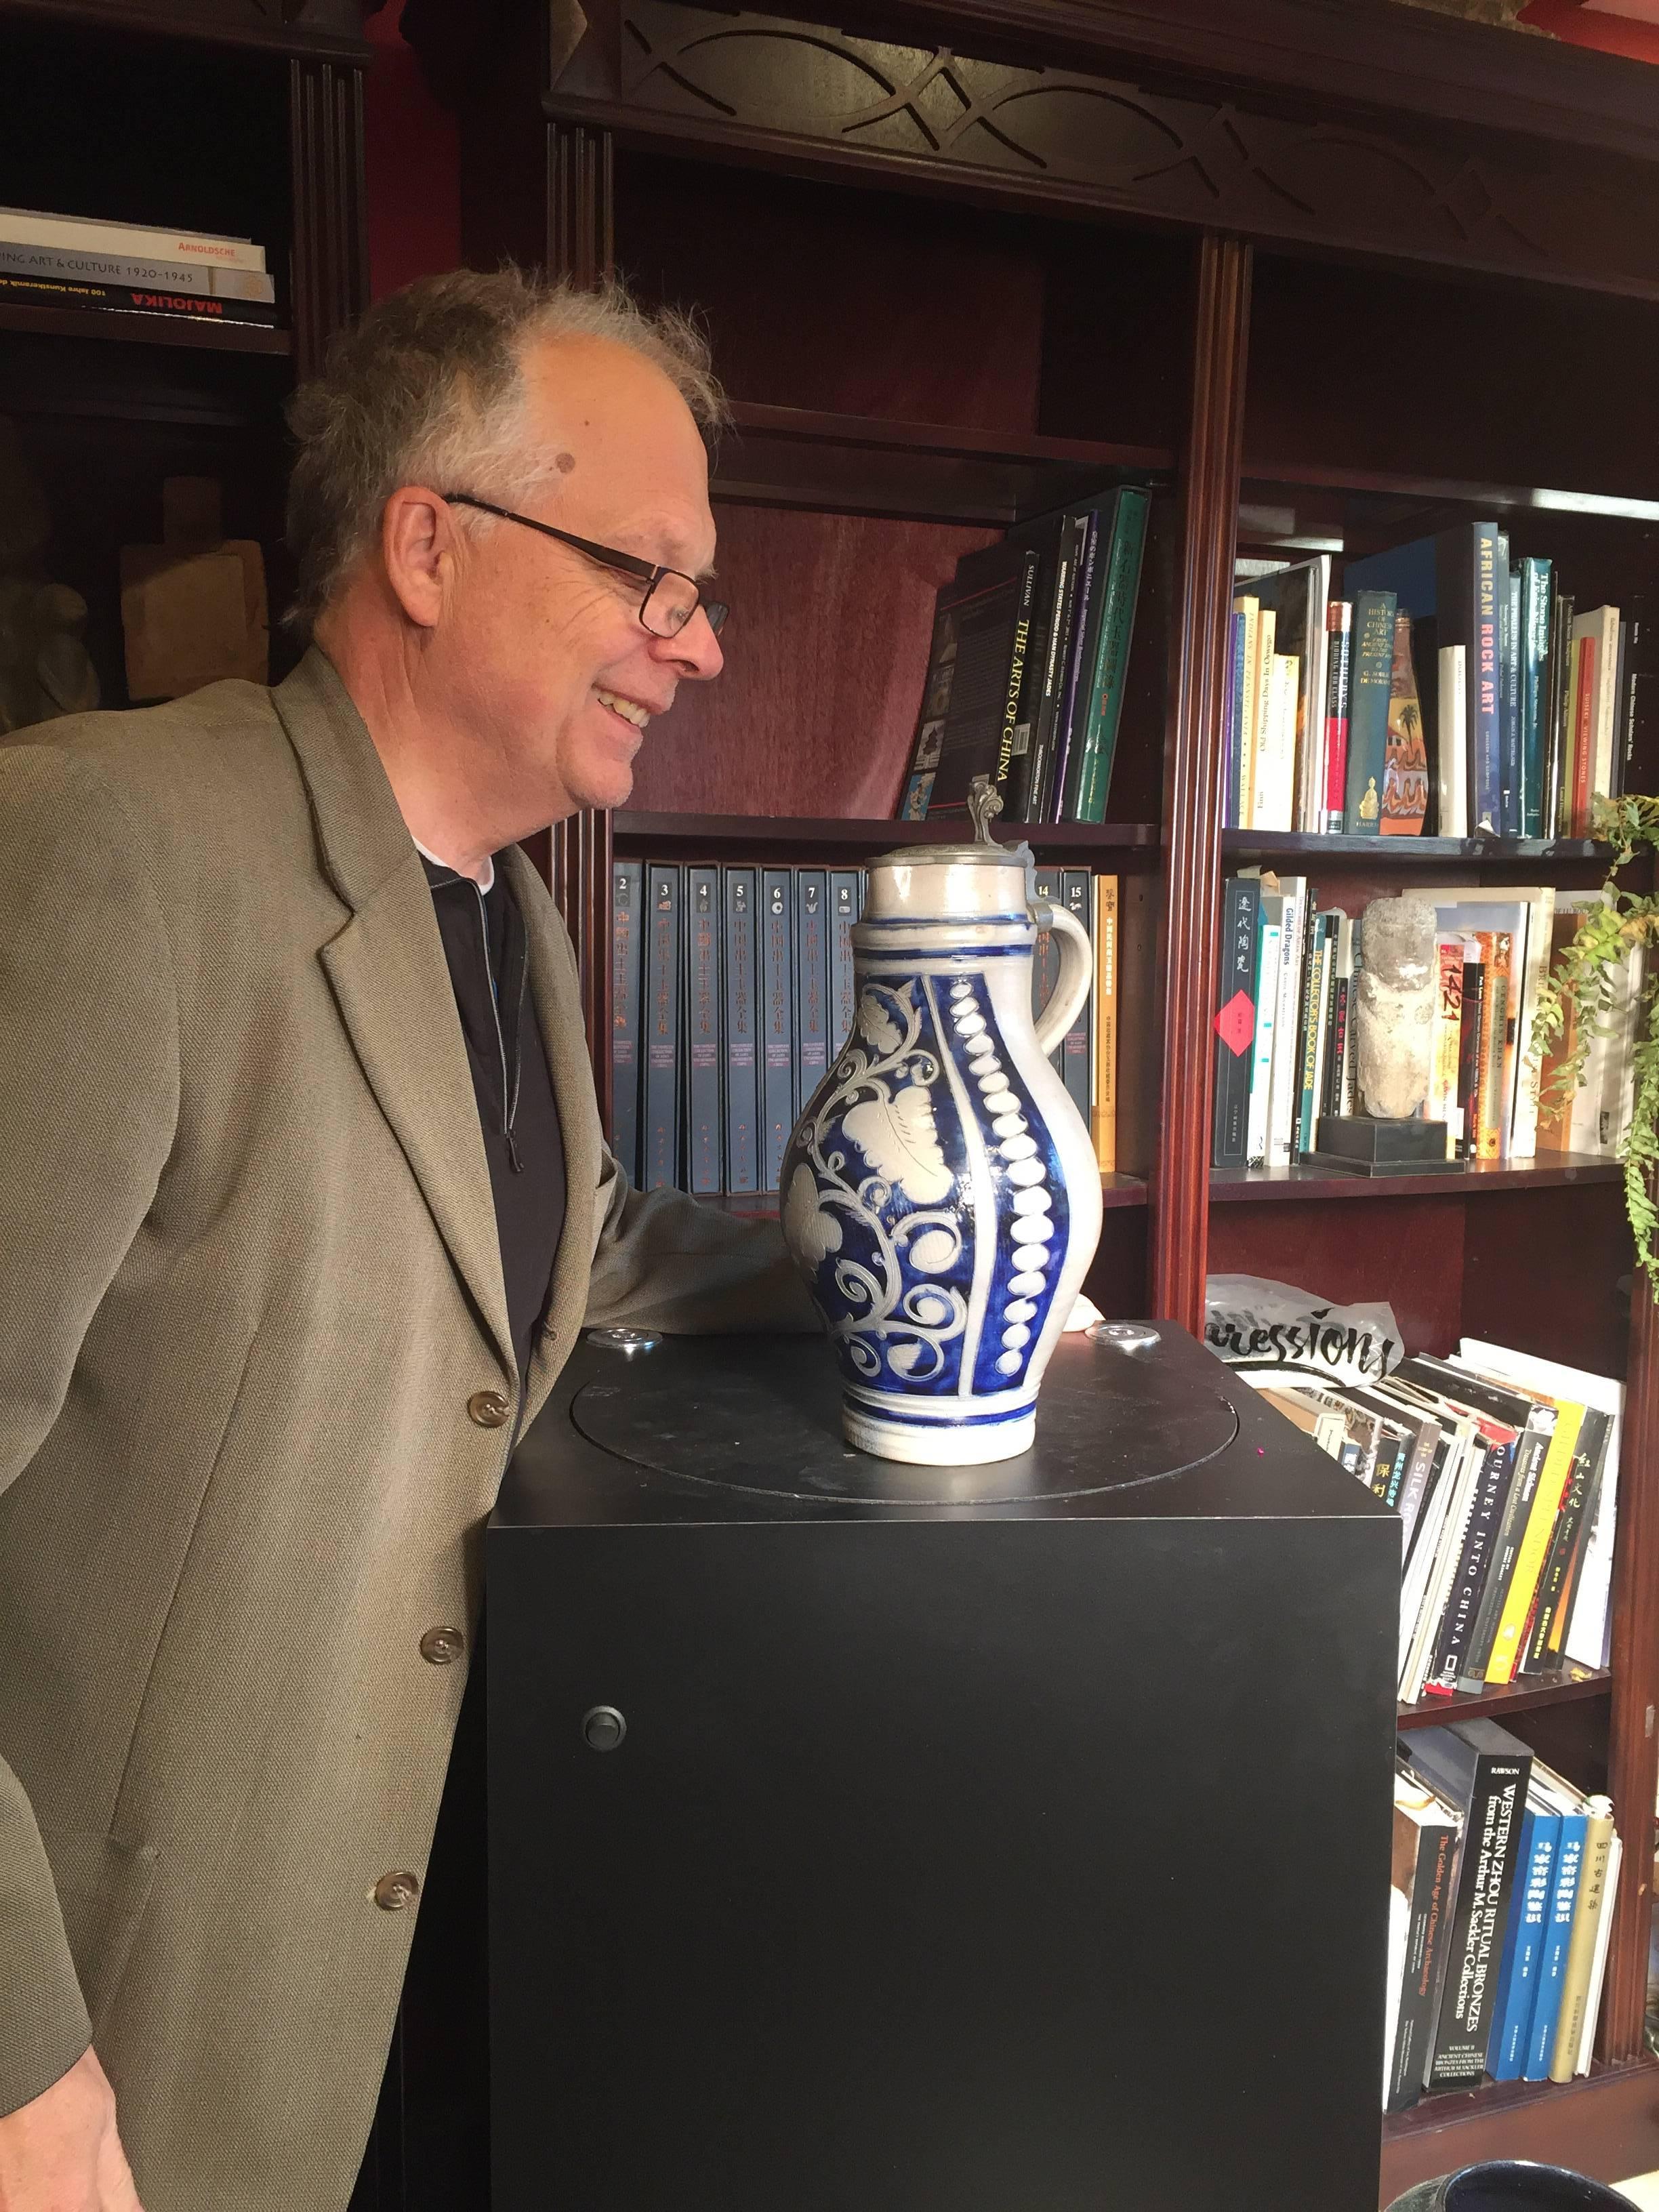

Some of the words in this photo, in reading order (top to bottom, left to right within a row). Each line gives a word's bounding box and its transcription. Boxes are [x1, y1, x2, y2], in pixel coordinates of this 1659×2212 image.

[178, 243, 235, 256] ARNOLDSCHE
[0, 251, 26, 264] ING
[28, 255, 54, 267] ART
[57, 259, 64, 268] &
[68, 260, 121, 274] CULTURE
[127, 267, 192, 283] 1920-1945
[131, 293, 224, 314] MAJOLIKA
[1023, 565, 1036, 606] SULLIVAN
[1059, 560, 1067, 588] WARRING
[1481, 538, 1494, 615] AFRICAN
[1540, 573, 1549, 594] The
[1540, 595, 1549, 623] Stone
[1015, 618, 1030, 654] THE
[1262, 634, 1272, 665] Oswego
[1481, 624, 1494, 672] ROCK
[1538, 626, 1547, 661] Images
[1008, 655, 1025, 699] ARTS
[1048, 651, 1057, 678] DYNASTY
[1262, 665, 1269, 676] In
[1261, 678, 1269, 697] Days
[1481, 680, 1494, 714] ART
[1006, 701, 1019, 724] OF
[1258, 699, 1269, 735] Shipping
[997, 726, 1016, 782] CHINA
[619, 878, 627, 889] 2
[661, 884, 668, 896] 3
[699, 884, 707, 896] 4
[737, 885, 743, 897] 5
[773, 888, 781, 899] 6
[808, 887, 815, 898] 7
[841, 888, 848, 900] 8
[1038, 886, 1048, 896] 14
[1071, 887, 1082, 897] 15
[1285, 907, 1294, 932] Gilded
[1282, 934, 1292, 965] Dragons
[1313, 949, 1323, 965] THE
[1309, 967, 1324, 1022] COLLECTOR'S
[1351, 952, 1366, 1010] Chinese
[1441, 964, 1462, 1021] 1421
[1498, 985, 1507, 1033] GENGHIS
[1307, 1025, 1318, 1053] BOOK
[1347, 1017, 1361, 1070] Carved
[1306, 1055, 1315, 1069] OF
[1305, 1070, 1314, 1090] JADE
[1344, 1076, 1359, 1113] Jades
[1519, 1448, 1532, 1474] Treasures
[1529, 1442, 1545, 1472] Ancient
[1410, 1462, 1426, 1500] SILK
[1481, 1446, 1505, 1520] OURNEY
[1516, 1473, 1525, 1487] from
[1521, 1471, 1538, 1502] Sichuan
[1513, 1492, 1521, 1504] Lost
[1504, 1504, 1519, 1536] Civilization
[1469, 1532, 1486, 1576] INTO
[1452, 1587, 1472, 1644] CHINA
[1486, 1796, 1501, 1825] from
[1494, 1784, 1516, 1858] WESTERN
[1439, 1835, 1449, 1851] The
[1482, 1828, 1496, 1847] the
[1435, 1853, 1446, 1883] Golden
[1475, 1849, 1492, 1891] Arthur
[1487, 1860, 1504, 1905] ZHOU
[1431, 1885, 1441, 1901] Age
[1432, 1902, 1440, 1911] of
[1473, 1892, 1486, 1909] M.
[1427, 1912, 1439, 1945] Chinese
[1466, 1910, 1482, 1952] Sackler
[1478, 1908, 1496, 1962] RITUAL
[1419, 1947, 1434, 1996] Archaeology
[1456, 1953, 1475, 2020] Collections
[1467, 1964, 1488, 2032] BRONZES
